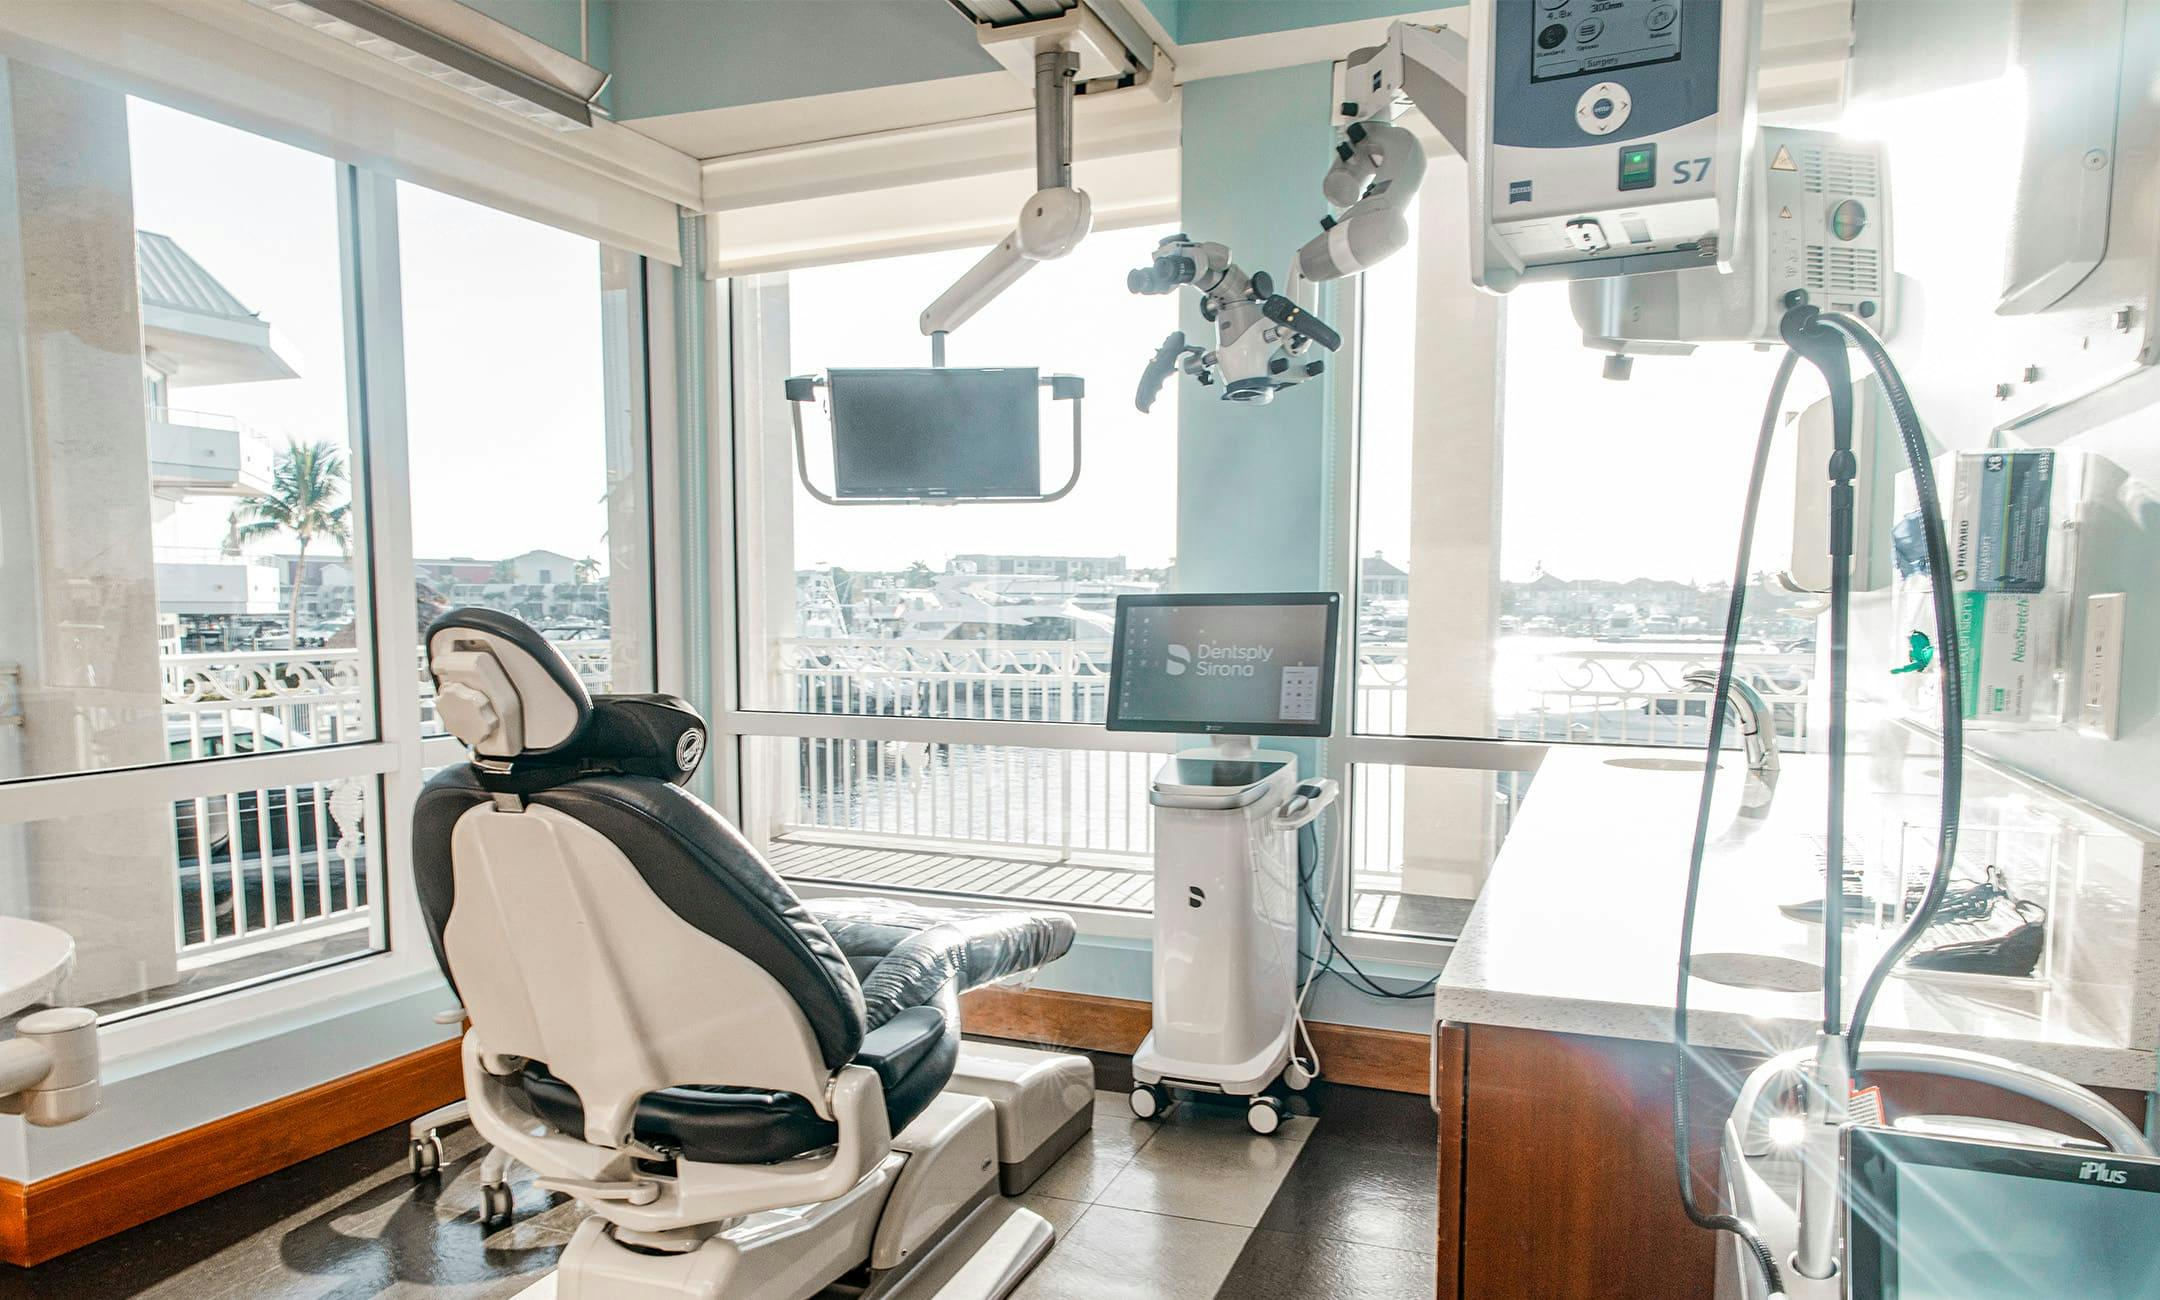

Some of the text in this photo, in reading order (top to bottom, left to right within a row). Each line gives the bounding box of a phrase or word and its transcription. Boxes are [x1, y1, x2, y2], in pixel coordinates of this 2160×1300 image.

[1587, 57, 1619, 69] Surgery
[1672, 156, 1713, 185] S7
[1957, 519, 1969, 568] HALYARD
[2011, 598, 2030, 664] NeoStretch
[1198, 644, 1274, 662] Dentsply
[1196, 661, 1255, 677] Sirona
[2078, 1161, 2128, 1184] iPlus
